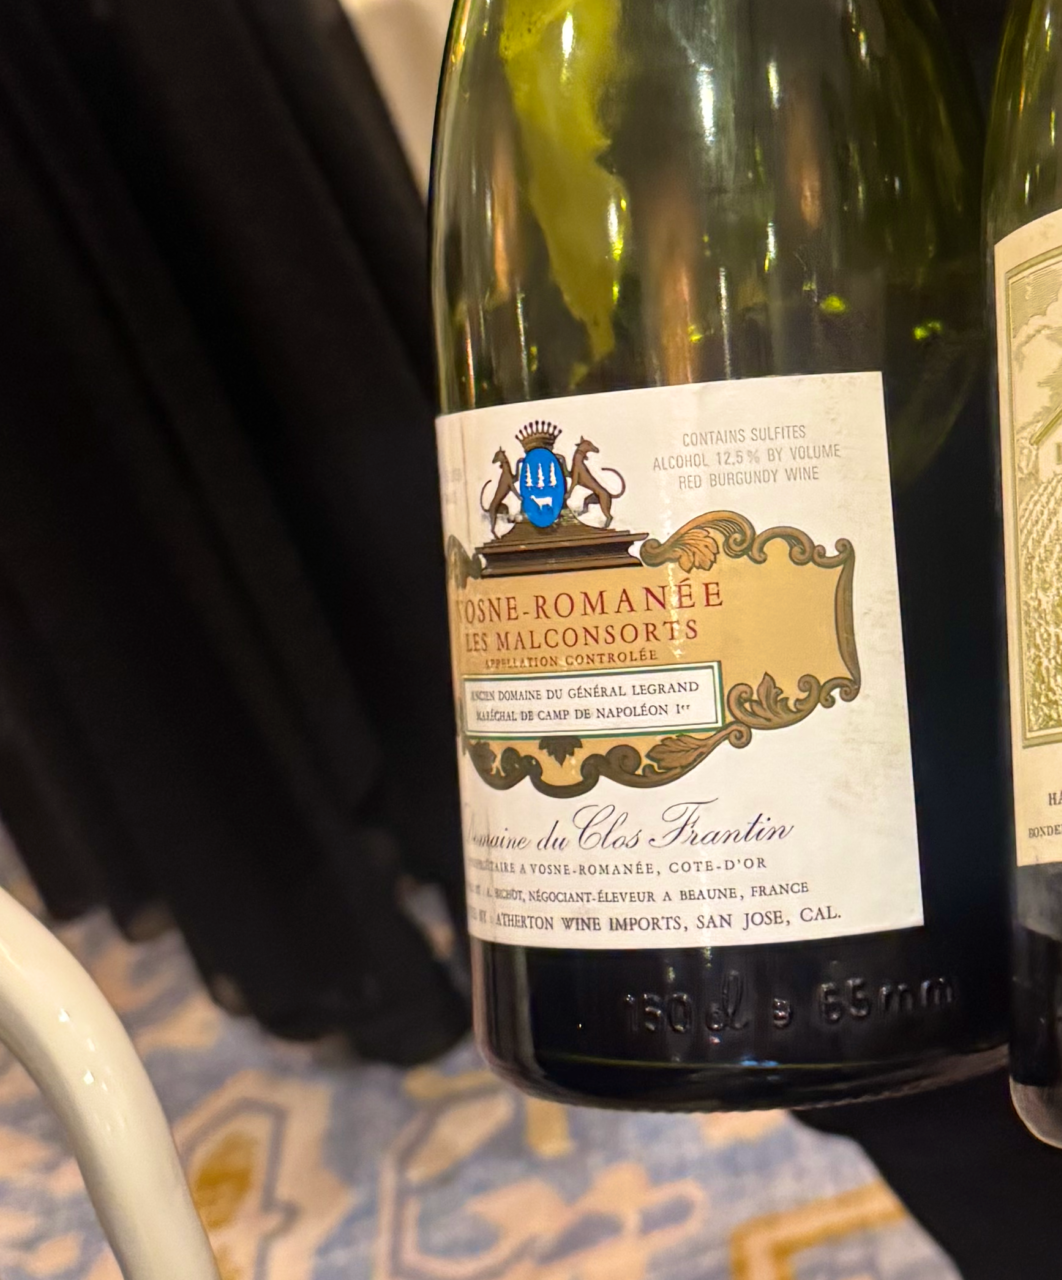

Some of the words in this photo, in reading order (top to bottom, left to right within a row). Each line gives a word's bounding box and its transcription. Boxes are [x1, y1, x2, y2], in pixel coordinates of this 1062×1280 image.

[683, 429, 746, 447] CONTAINS
[751, 425, 807, 442] SULFITES
[653, 453, 710, 471] ALCOHOL
[767, 448, 783, 462] BY
[790, 444, 842, 460] VOLUME
[679, 475, 702, 490] RED
[709, 469, 778, 487] BURGUNDY
[785, 466, 820, 481] WINE
[465, 632, 488, 653] LES
[496, 619, 698, 652] MALCONSORTS
[485, 656, 558, 669] APPELLATION
[565, 647, 658, 666] CONTROLÉE
[499, 689, 542, 701] DOMAINE
[546, 688, 563, 700] DU
[567, 684, 627, 699] GÉNÉRAL
[632, 681, 699, 696] LEGRAND
[476, 708, 518, 721] MARÉCHAL
[521, 710, 534, 721] DE
[537, 709, 570, 721] CAMP
[575, 708, 591, 719] DE
[596, 703, 669, 719] NAPOLÉON
[537, 820, 569, 851] du
[572, 804, 642, 851] Clos
[648, 797, 795, 849] Frantin
[467, 858, 516, 874] IÉTAIRE
[519, 866, 527, 874] A
[530, 861, 661, 876] VOSNE-ROMANÉE,
[669, 857, 767, 874] COTE-D'OR
[528, 888, 655, 904] NÉGOCIANT-ÉLEVEUR
[662, 891, 672, 902] A
[680, 887, 745, 901] BEAUNE,
[751, 881, 809, 898] FRANCE
[496, 912, 554, 930] ATHERTON
[561, 917, 602, 931] WINE
[609, 914, 688, 932] IMPORTS,
[696, 913, 733, 929] SAN
[743, 910, 791, 931] JOSE,
[800, 905, 842, 923] CAL.
